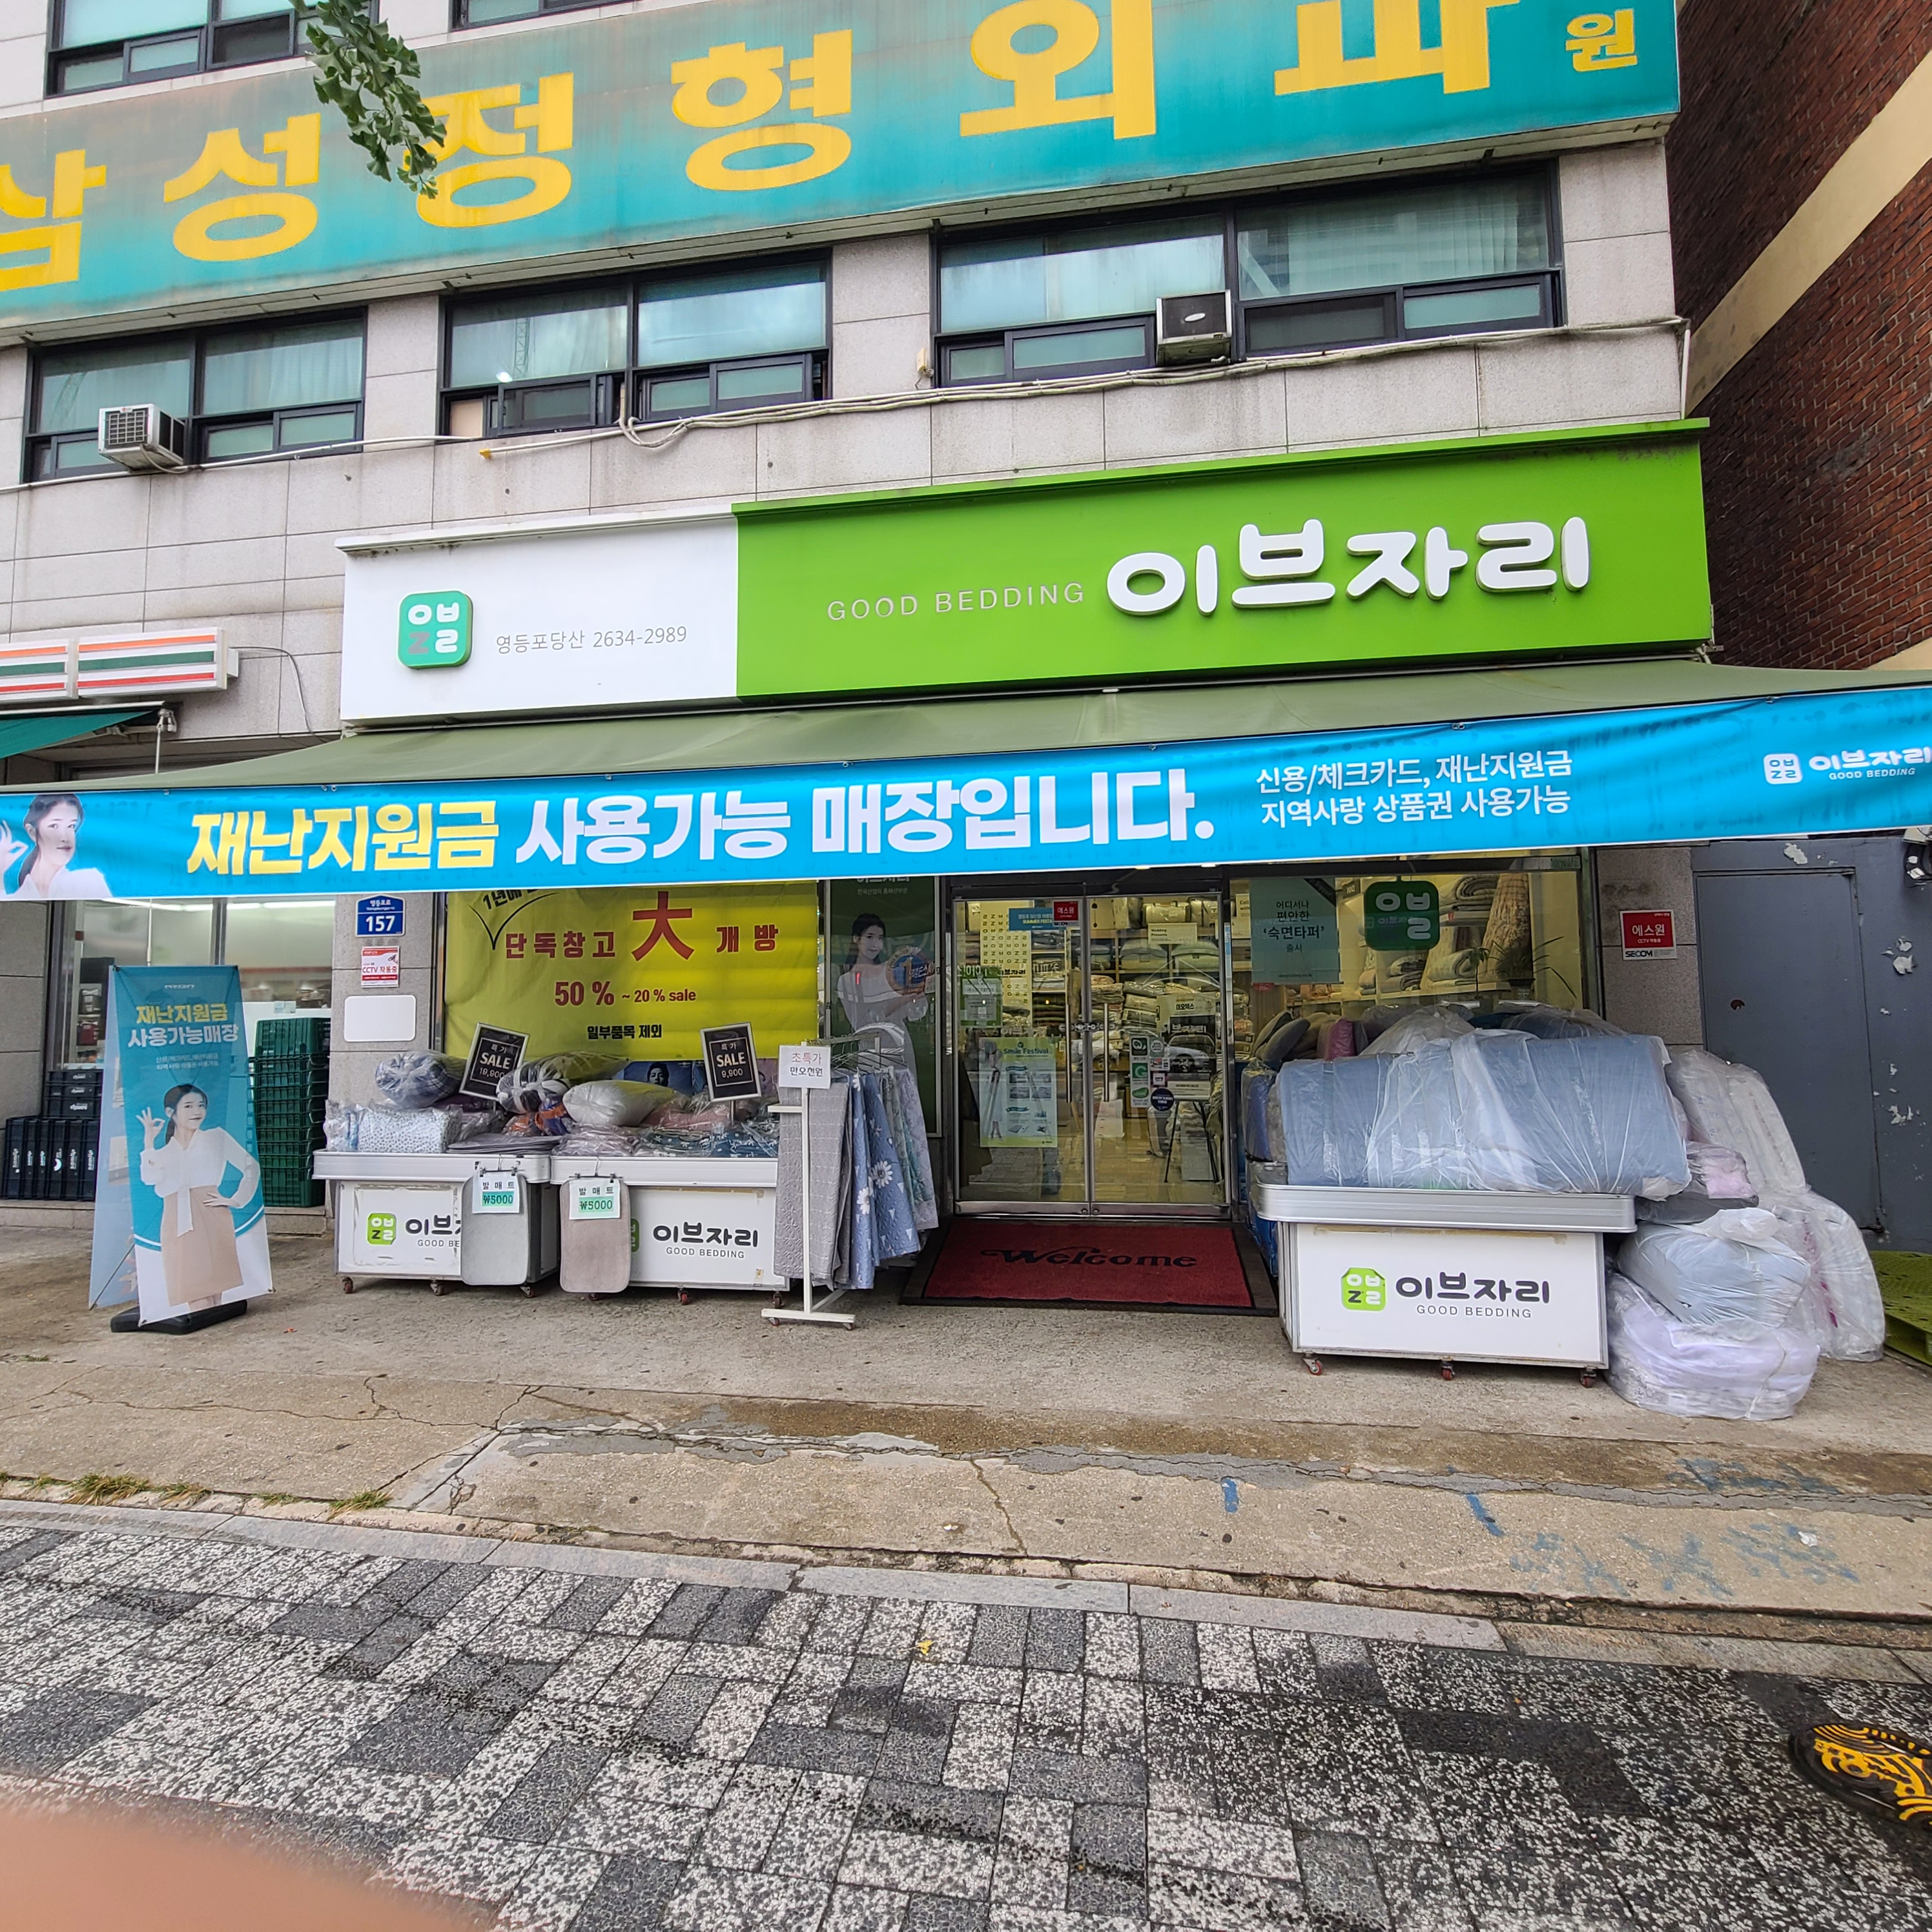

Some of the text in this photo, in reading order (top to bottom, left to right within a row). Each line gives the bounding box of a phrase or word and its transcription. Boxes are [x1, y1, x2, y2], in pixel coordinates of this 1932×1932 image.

[1566, 8, 1638, 72] 원
[1106, 517, 1590, 617] 이브자리
[827, 582, 1085, 620] GOOD BEDDING
[496, 626, 686, 653] 영등포당산 2634-2989
[1809, 746, 1932, 770] 이브자리
[1255, 750, 1573, 794] 신용/체크카드, 재난지원금
[1829, 768, 1915, 780] GOOD BEDDING
[1261, 785, 1572, 829] 지역사랑 상품권 사용가능
[187, 768, 1215, 876] 재난지원금 사용가능 매장입니다.
[1276, 900, 1309, 910] 어디서나
[365, 916, 395, 932] 157
[1277, 910, 1310, 922] 편안한
[1632, 924, 1665, 936] 에스원
[505, 930, 615, 960] 단독창고
[1286, 944, 1302, 953] 출시
[668, 988, 697, 1002] sale
[136, 1003, 227, 1024] 재난지원금
[128, 1024, 239, 1047] 사용가능매장
[587, 1024, 663, 1040] 일부품목 제외
[479, 1052, 511, 1069] SALE
[716, 1052, 746, 1067] SALE
[792, 1053, 822, 1065] 초특가
[721, 1068, 743, 1078] 9,900
[406, 1214, 461, 1235] 이브
[653, 1222, 758, 1248] 이브자리
[666, 1247, 745, 1259] GOOD BEDDING
[980, 1246, 1197, 1268] Welcome
[1395, 1271, 1550, 1304] 이브자리
[1416, 1304, 1532, 1318] GOOD BEDDING
